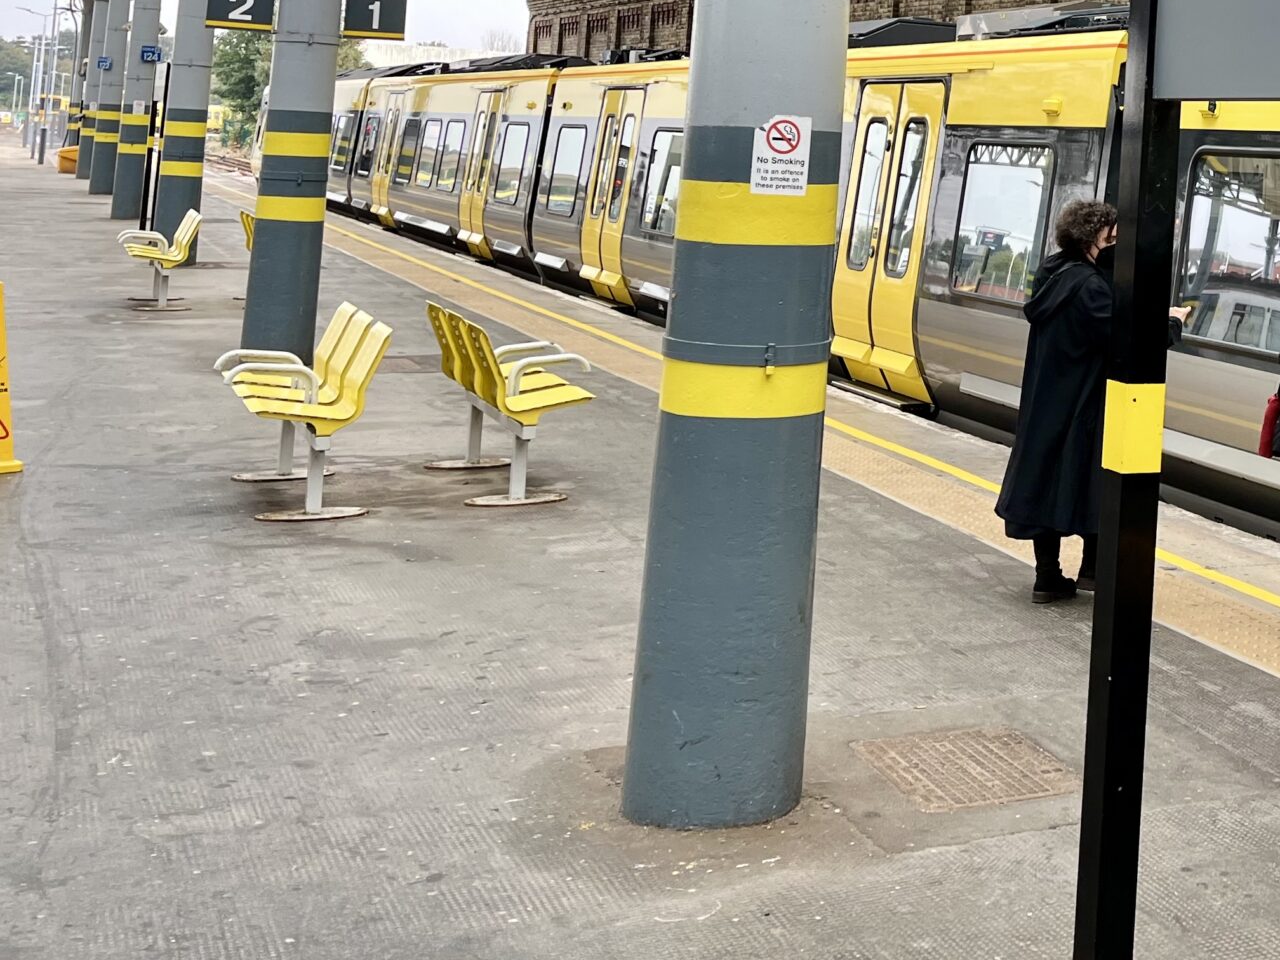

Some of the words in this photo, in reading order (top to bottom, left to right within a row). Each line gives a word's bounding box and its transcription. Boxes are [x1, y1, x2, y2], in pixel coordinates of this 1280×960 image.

[368, 0, 381, 30] 1
[143, 52, 159, 61] 124
[756, 156, 769, 164] No
[771, 157, 805, 168] Smoking
